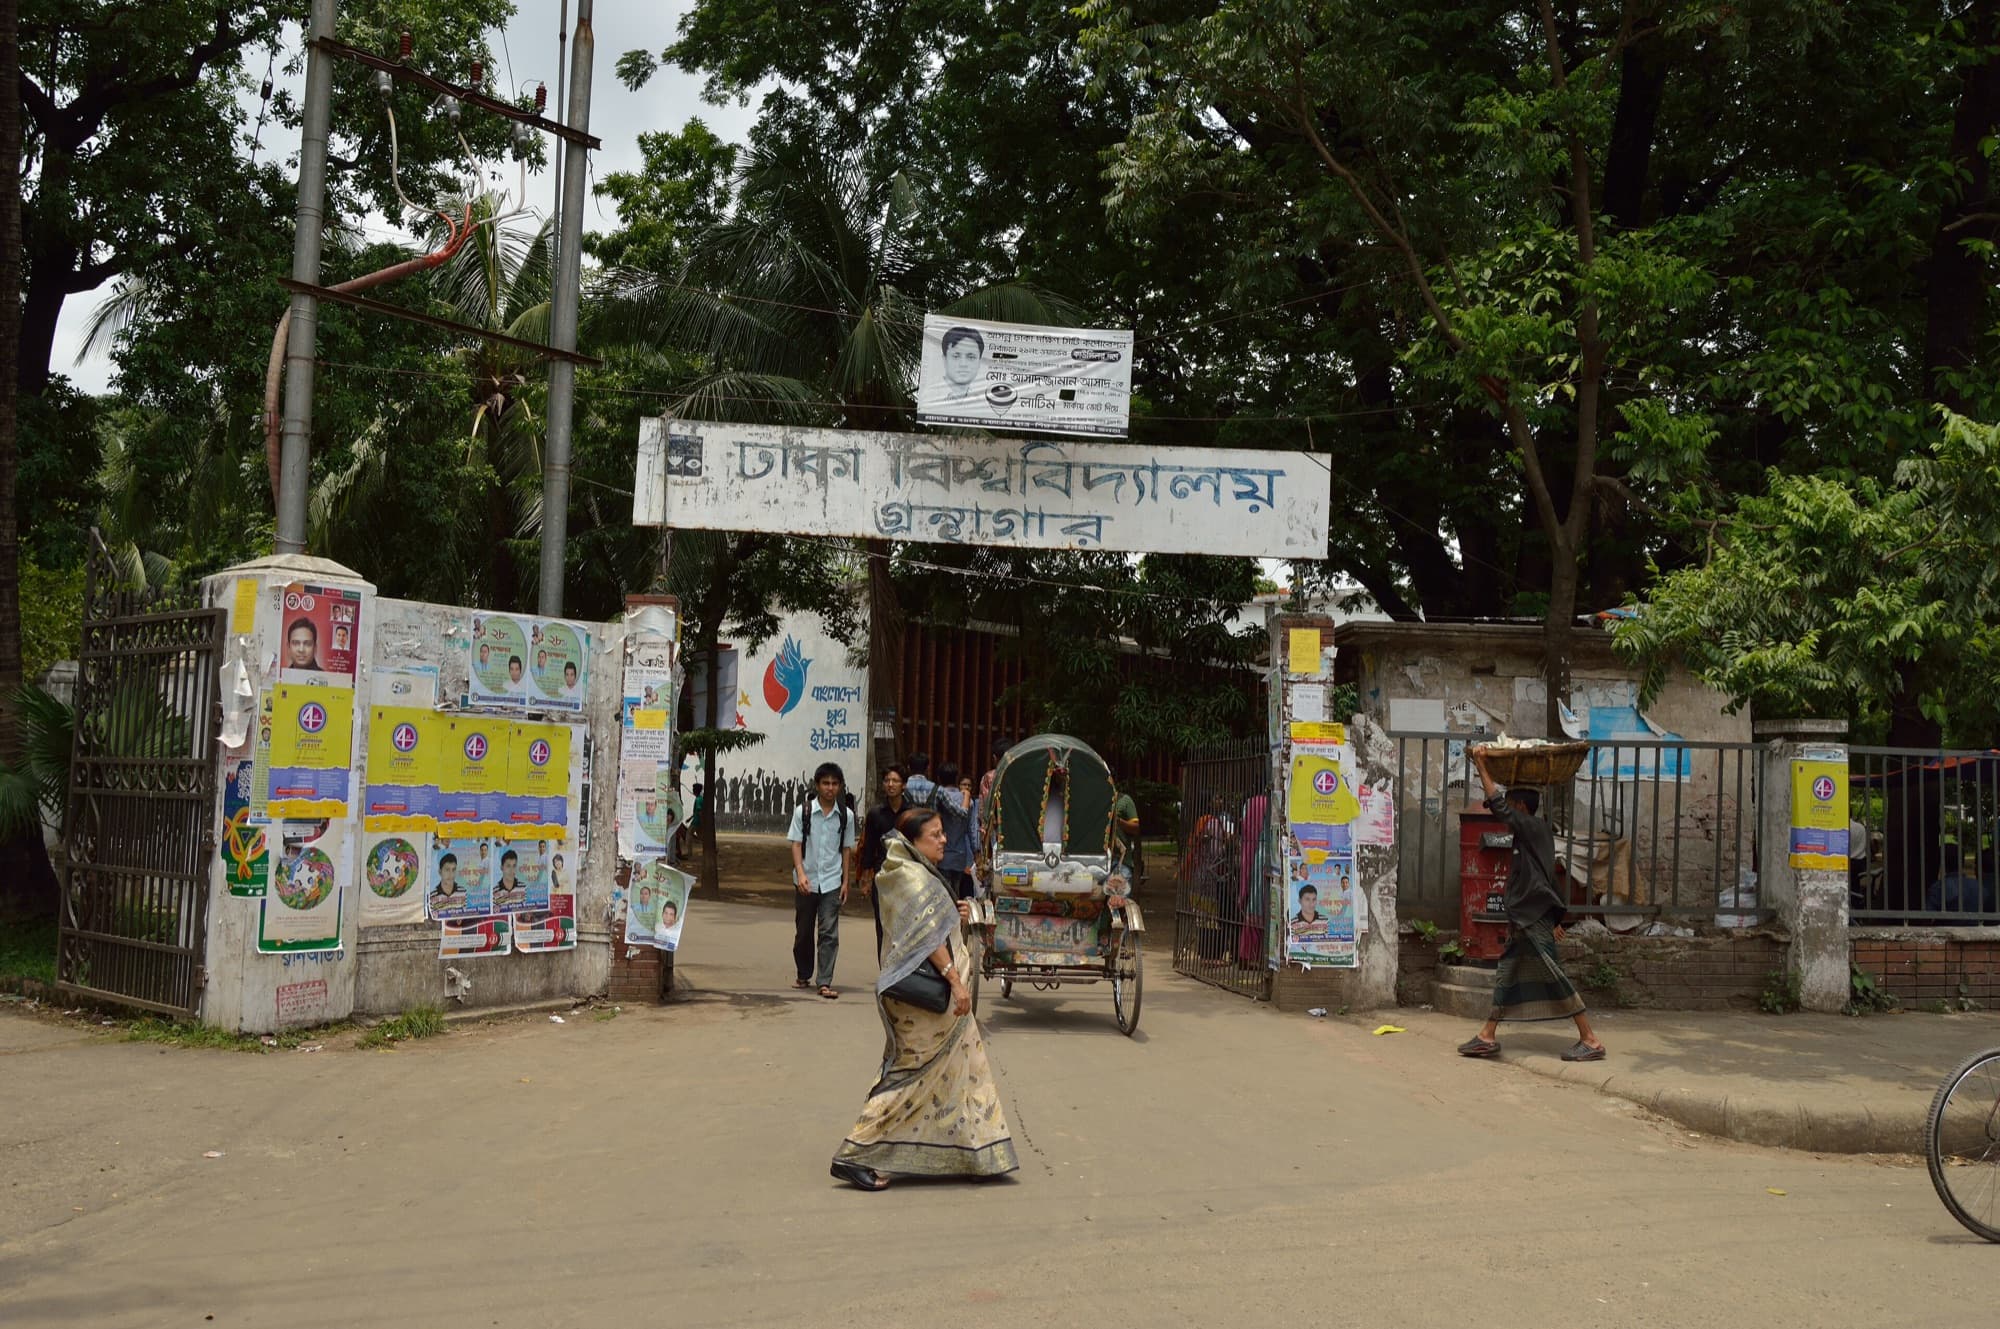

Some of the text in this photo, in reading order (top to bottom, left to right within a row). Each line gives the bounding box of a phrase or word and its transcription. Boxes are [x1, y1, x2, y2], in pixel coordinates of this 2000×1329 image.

[1014, 333, 1034, 342] ঢাকা
[1062, 335, 1080, 346] সিটি
[1080, 378, 1110, 388] আসাদ
[1020, 393, 1055, 410] লাটিম
[1086, 402, 1103, 411] ভোট
[732, 438, 1286, 514] ঢাকা বিশ্ববিদ্যালয়
[873, 500, 1113, 546] গ্রন্থাগার
[811, 685, 861, 704] বাংলাদেশ
[825, 708, 848, 727] ছাত্র
[809, 727, 861, 752] ইউনিয়ন
